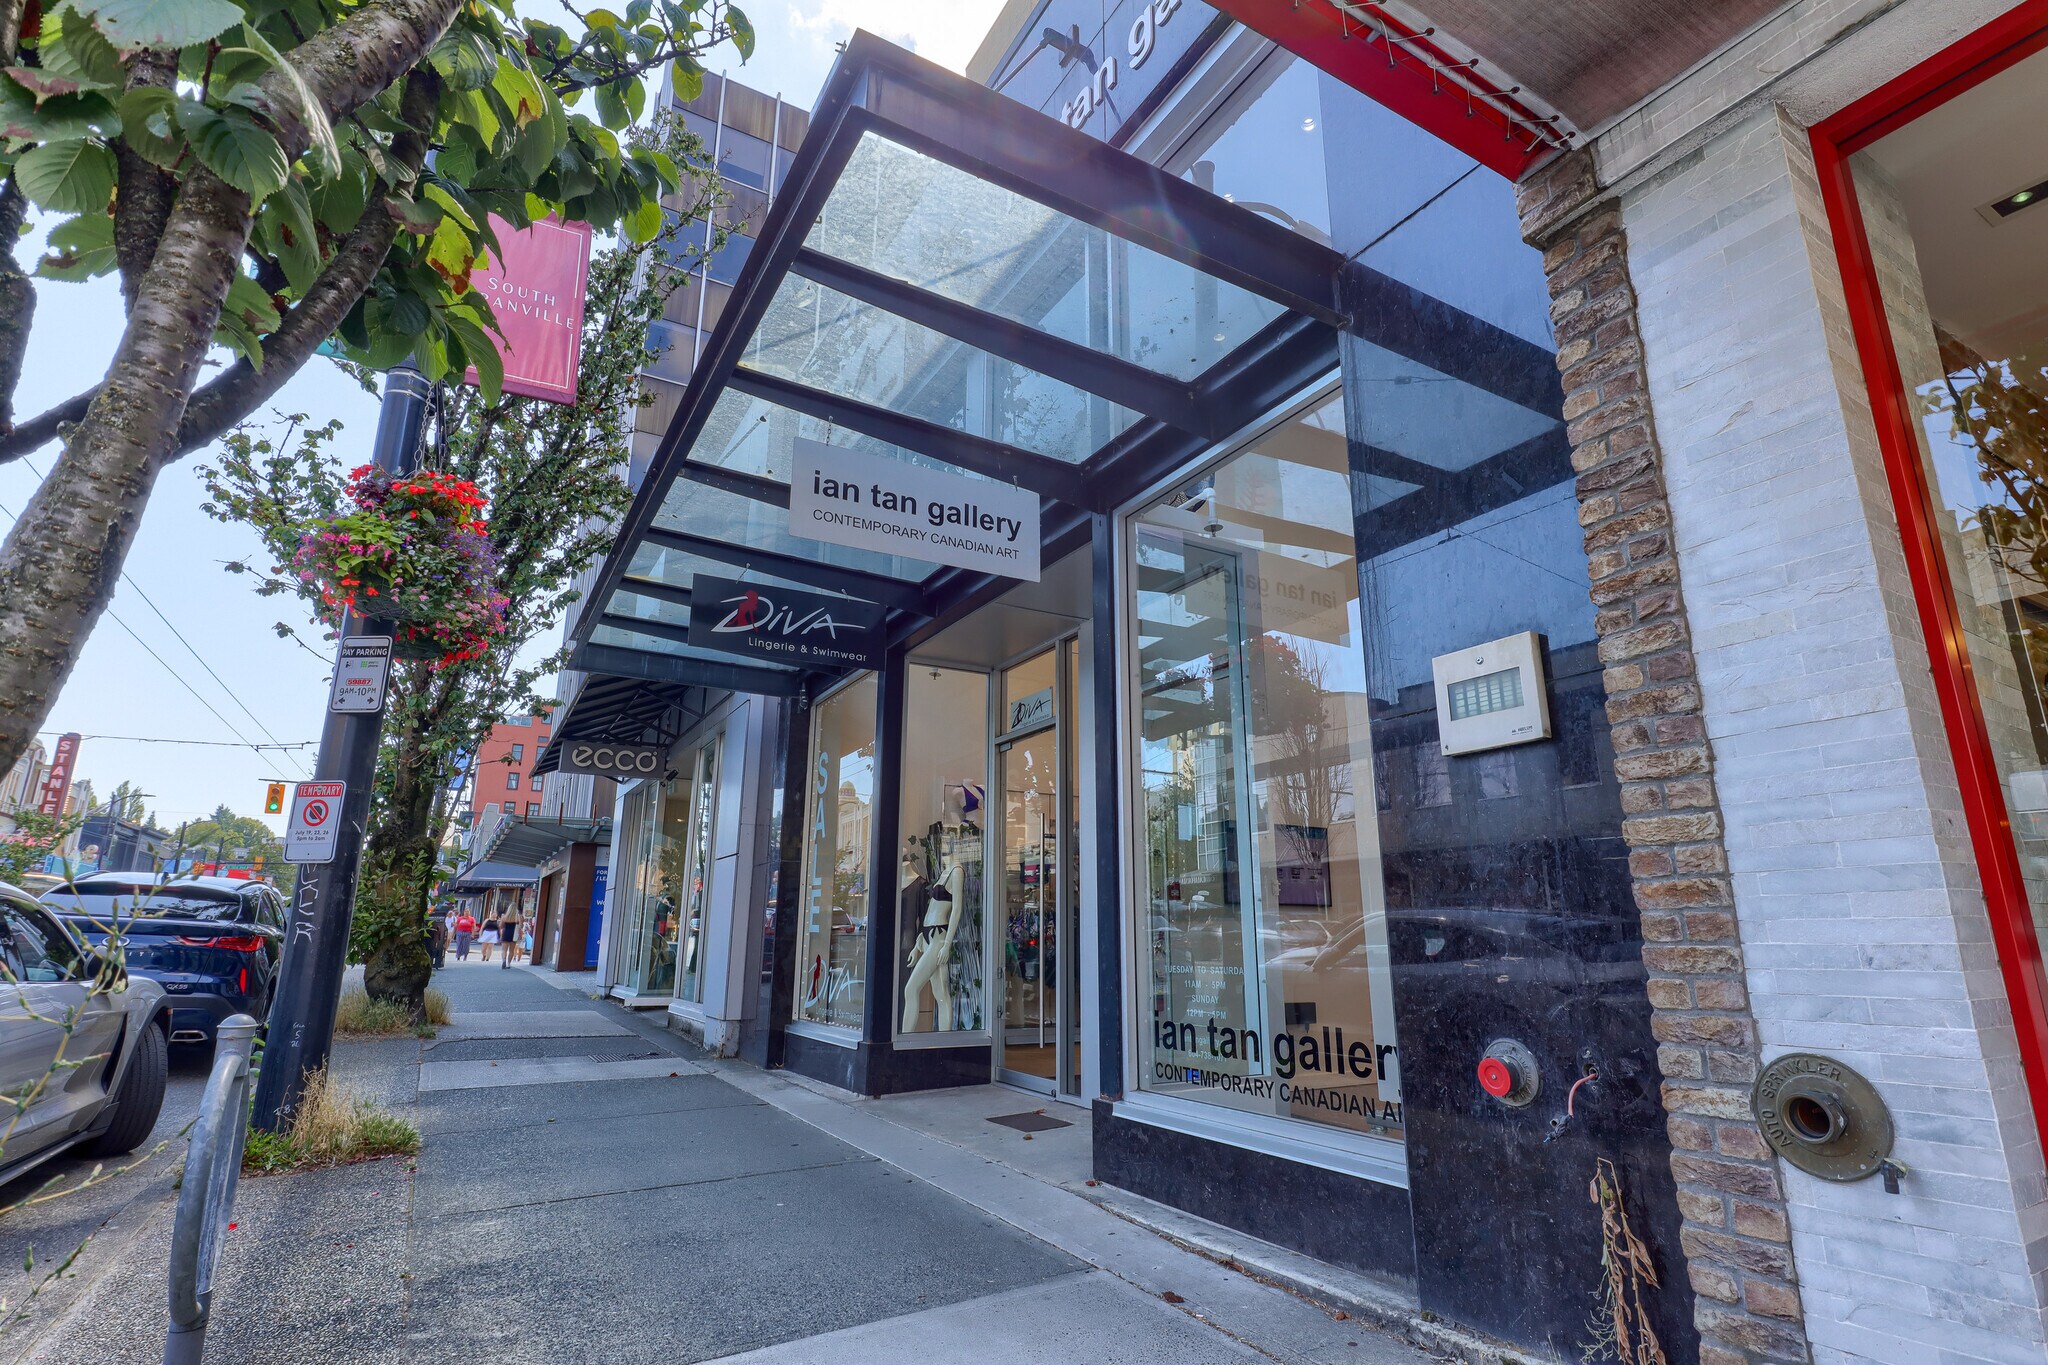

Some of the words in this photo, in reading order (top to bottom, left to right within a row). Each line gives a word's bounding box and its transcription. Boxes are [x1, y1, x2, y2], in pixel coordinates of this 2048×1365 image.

[487, 277, 556, 307] SOUTH
[481, 292, 575, 330] ANVILLE
[813, 469, 860, 503] ian
[870, 484, 917, 516] tan
[927, 501, 1022, 542] gallery
[813, 509, 927, 541] CONTEMPORARY
[930, 533, 994, 555] CANADIAN
[996, 546, 1020, 560] ART
[341, 648, 355, 657] PAY
[356, 648, 388, 657] PARKING
[748, 636, 796, 652] Lingerie
[800, 644, 808, 654] &
[813, 646, 867, 662] Swimwear
[572, 745, 658, 772] ecco
[43, 740, 71, 814] STANLE
[299, 785, 341, 796] TEMPORARY
[808, 751, 829, 933] SALE
[1165, 965, 1194, 974] TUESDAY
[1197, 965, 1207, 974] TO
[1210, 966, 1245, 975] SATURDA
[1184, 980, 1202, 988] 11AM
[1211, 981, 1227, 989] 5PM
[1186, 1009, 1204, 1018] 12PM
[1191, 994, 1219, 1004] SUNDAY
[1154, 1009, 1197, 1053] ian
[1207, 1017, 1260, 1063] tan
[1155, 1062, 1275, 1099] CONTEMPORARY
[1279, 1083, 1377, 1118] CANADIAN
[1761, 1059, 1841, 1099] SPRINKLER
[1762, 1108, 1793, 1148] AUTO
